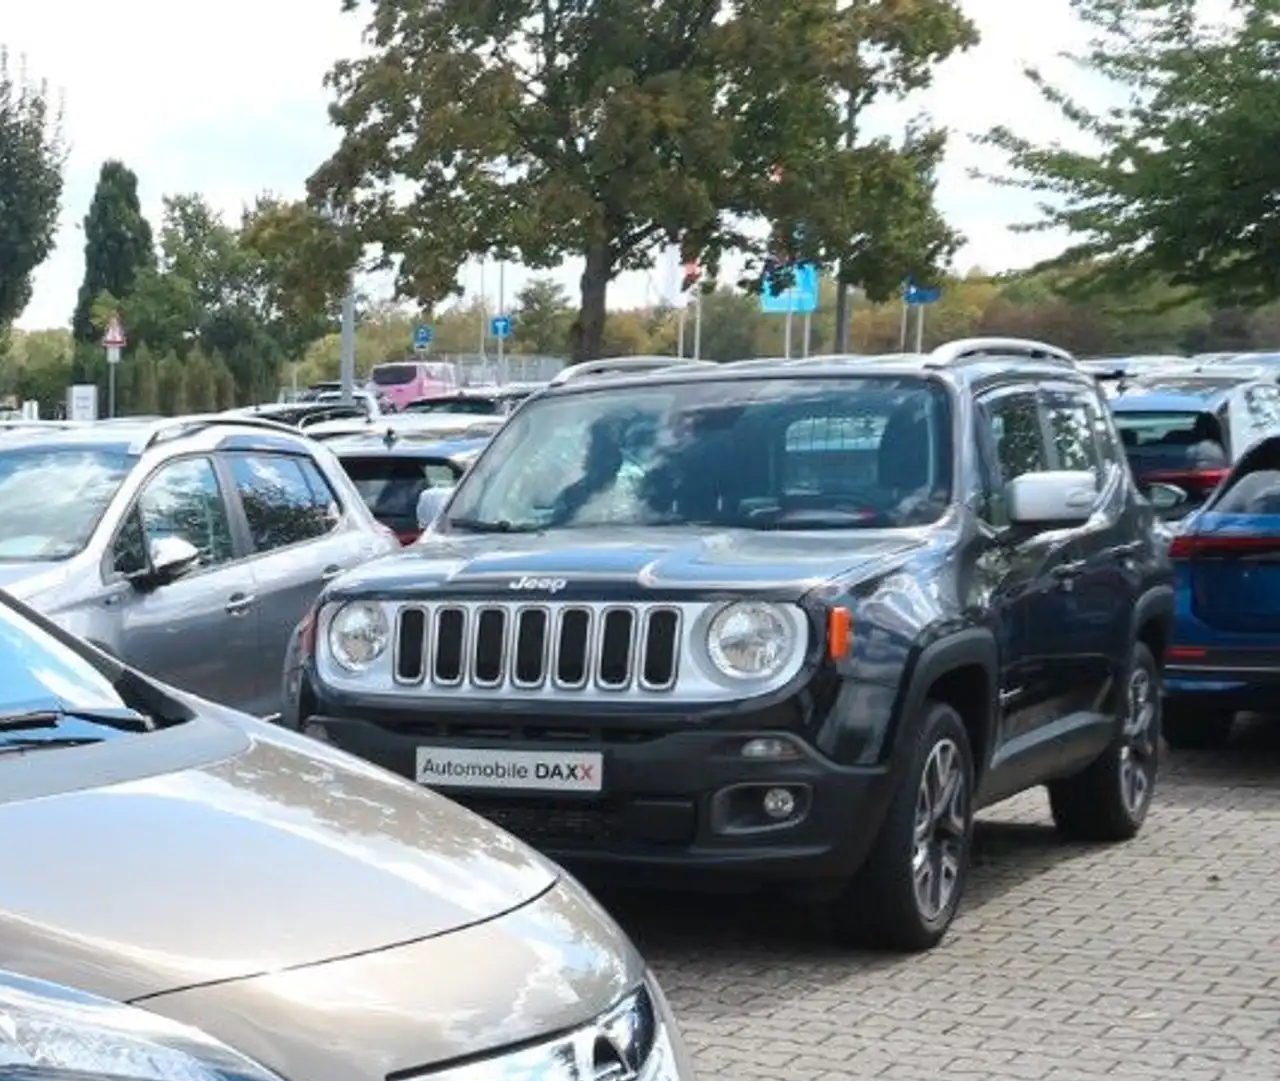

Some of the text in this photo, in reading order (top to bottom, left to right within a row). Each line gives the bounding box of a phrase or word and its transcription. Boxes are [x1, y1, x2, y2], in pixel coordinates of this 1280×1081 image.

[509, 576, 567, 594] Jeep
[422, 758, 594, 780] Automobile DAXX
